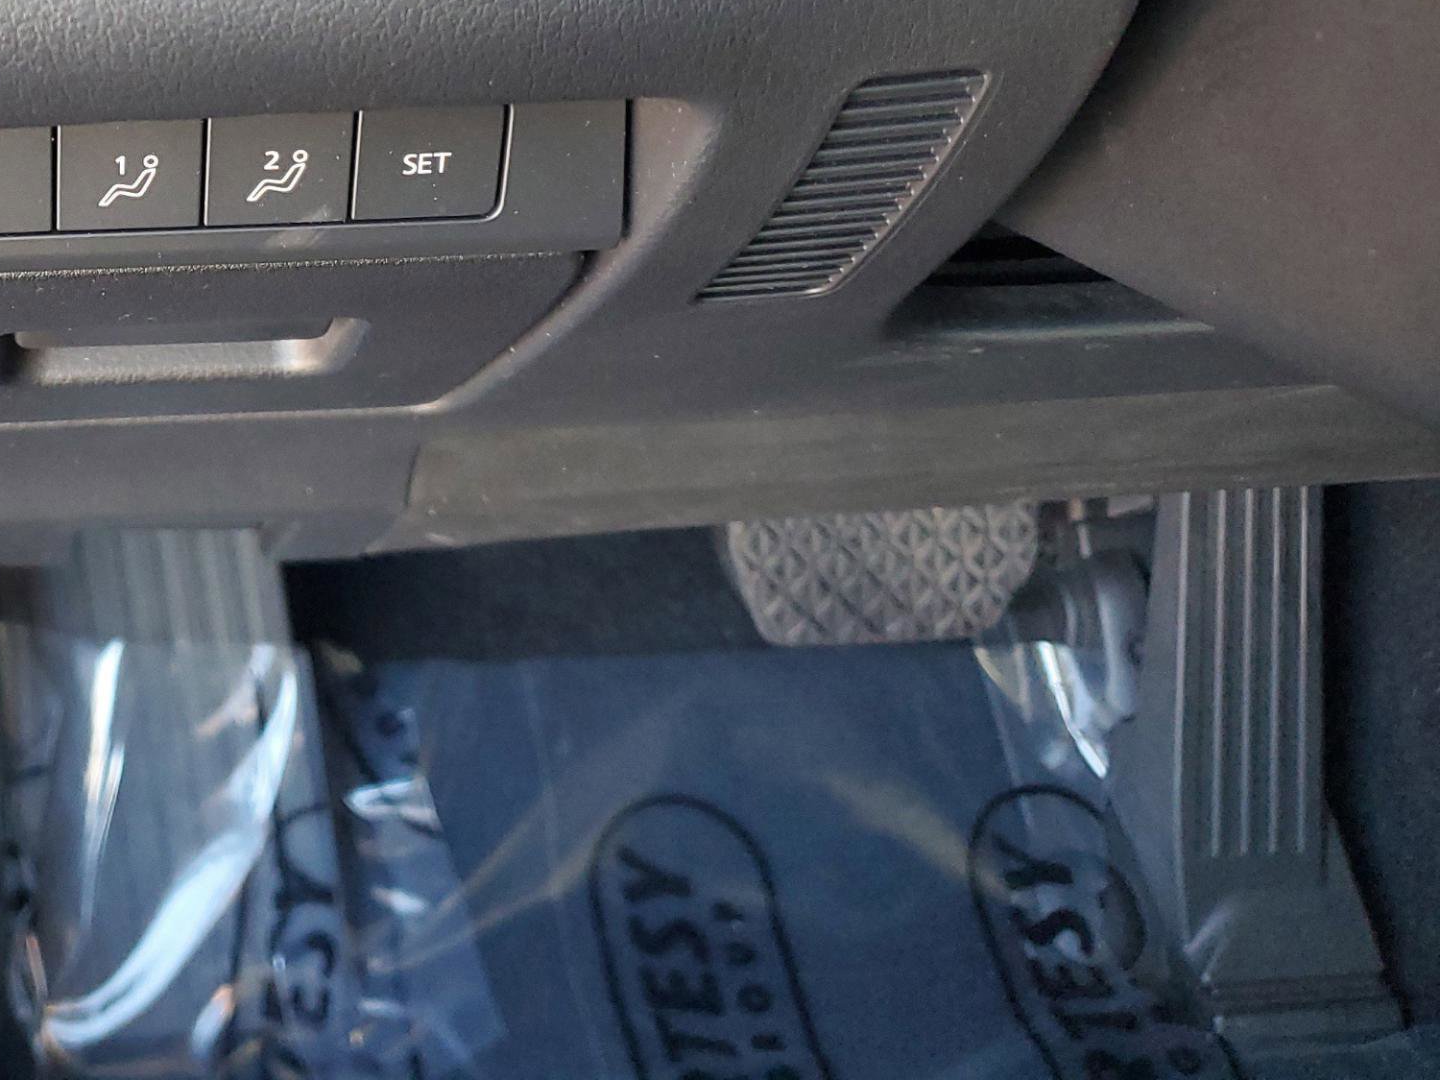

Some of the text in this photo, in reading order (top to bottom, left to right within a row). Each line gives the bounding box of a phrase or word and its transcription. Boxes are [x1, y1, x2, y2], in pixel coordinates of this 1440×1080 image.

[114, 155, 126, 176] 1
[263, 151, 280, 170] 2
[402, 152, 452, 176] SET
[616, 844, 752, 1080] TESY
